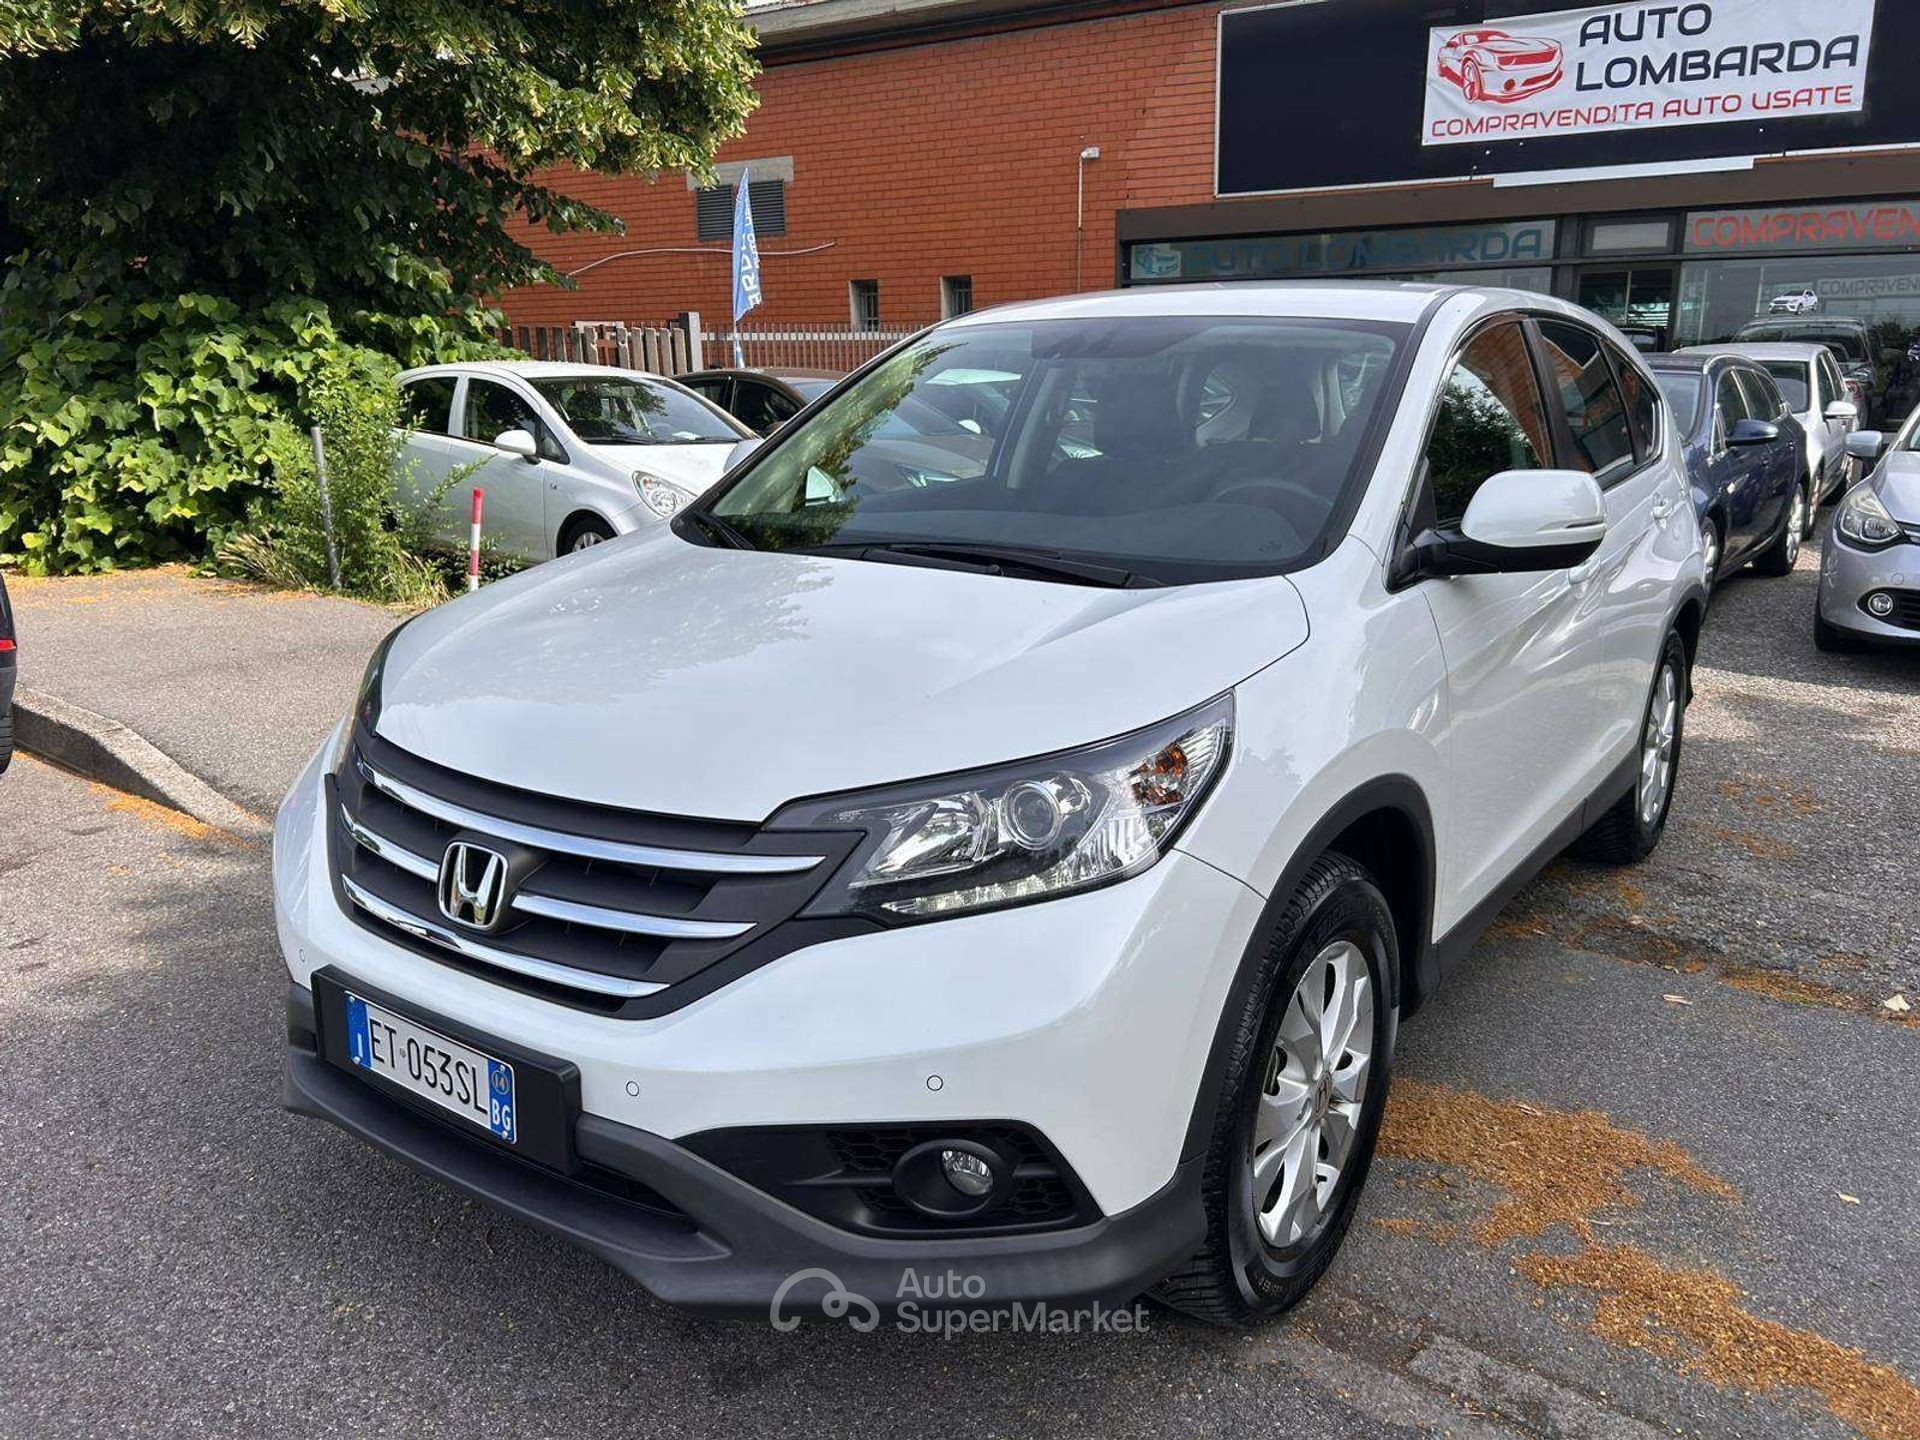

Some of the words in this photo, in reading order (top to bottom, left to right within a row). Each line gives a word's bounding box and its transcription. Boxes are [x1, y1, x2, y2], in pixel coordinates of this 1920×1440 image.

[1578, 3, 1712, 48] AUTO
[1575, 34, 1860, 92] LOMBARDA
[1431, 101, 1655, 138] COMPRAVENDITA
[1662, 94, 1742, 119] AUTO
[1752, 84, 1854, 111] USATE
[491, 1098, 512, 1131] BG
